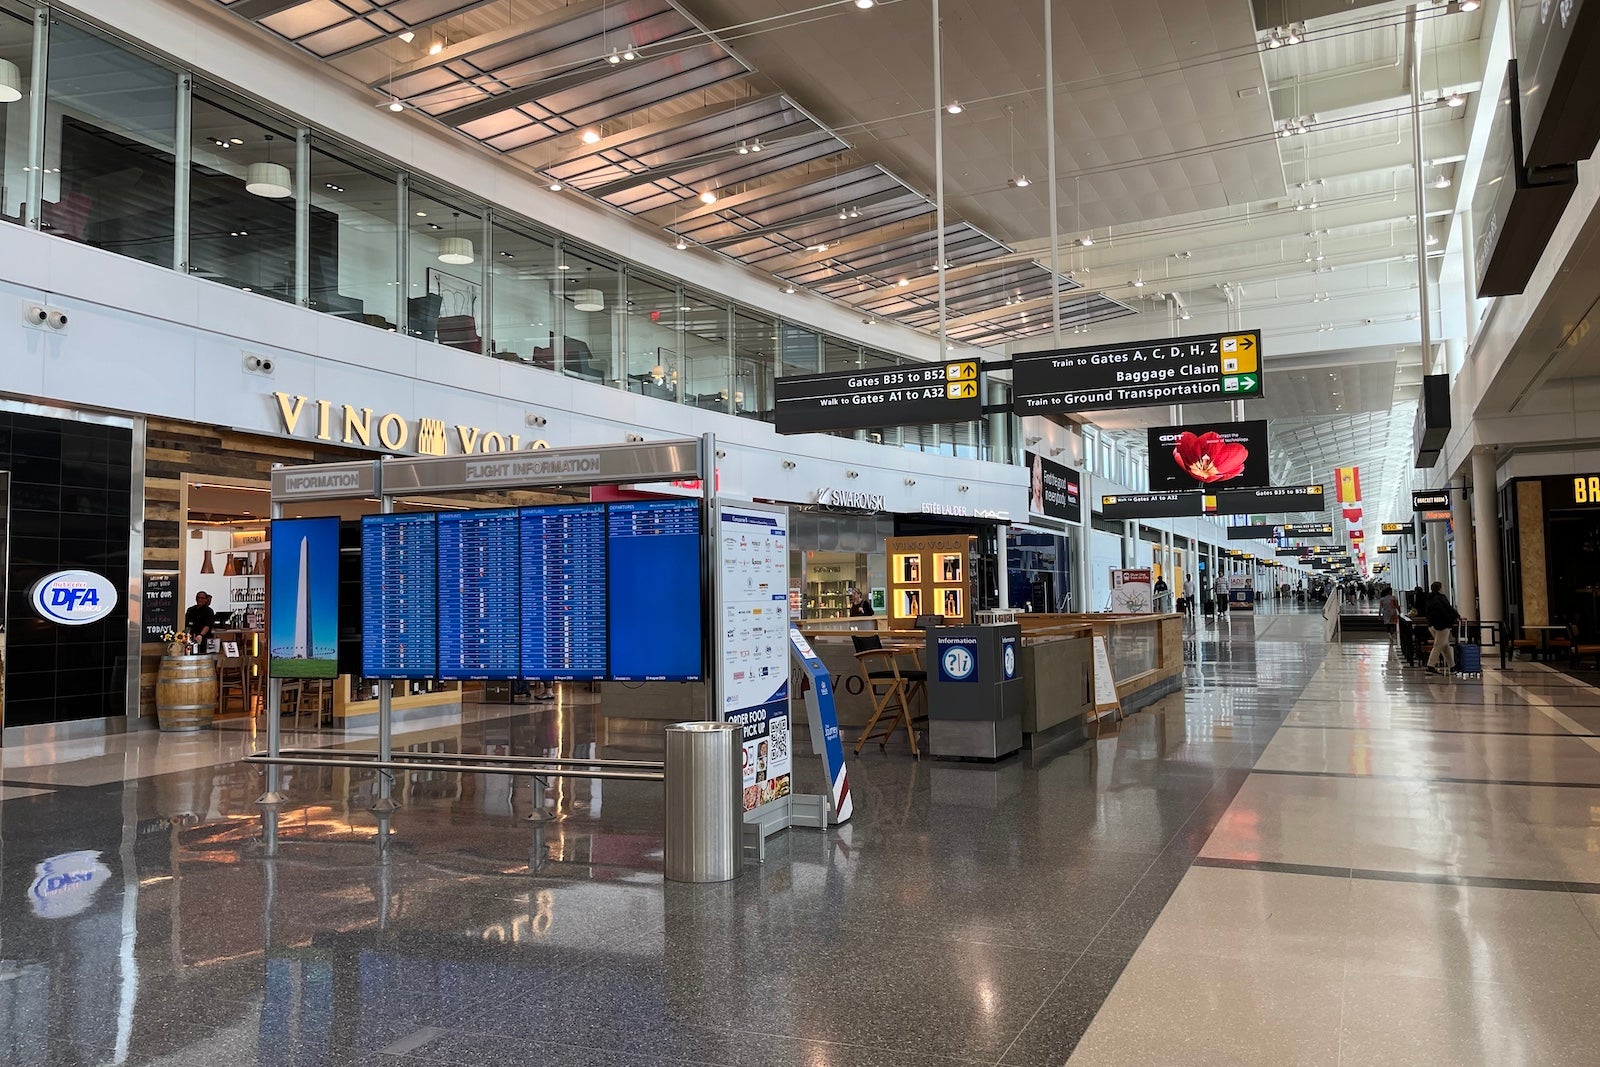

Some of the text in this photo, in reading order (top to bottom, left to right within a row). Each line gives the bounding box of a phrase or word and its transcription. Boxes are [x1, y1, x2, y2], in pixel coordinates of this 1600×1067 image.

[1052, 343, 1218, 368] Train to Gates A, C, D, H, Z
[848, 370, 945, 388] Gates B35 to B52
[1116, 364, 1218, 382] Baggage Claim
[820, 398, 839, 407] Walk
[852, 394, 884, 405] Gates
[889, 391, 902, 402] A1
[906, 390, 918, 400] to
[922, 388, 944, 399] A32
[1026, 382, 1220, 406] Train to Ground Transportation
[273, 391, 409, 450] VINO
[1159, 434, 1184, 442] GDIT
[467, 457, 600, 480] FLIGHT INFORMATION
[287, 472, 359, 490] INFORMATION
[831, 489, 886, 510] SWAROVSKI
[922, 502, 966, 516] ESTÉE LAUDER
[892, 540, 962, 550] VINO VOLO
[52, 588, 100, 611] DFA
[146, 591, 159, 599] TRY
[749, 709, 766, 722] FOOD
[743, 722, 766, 738] PICK UP
